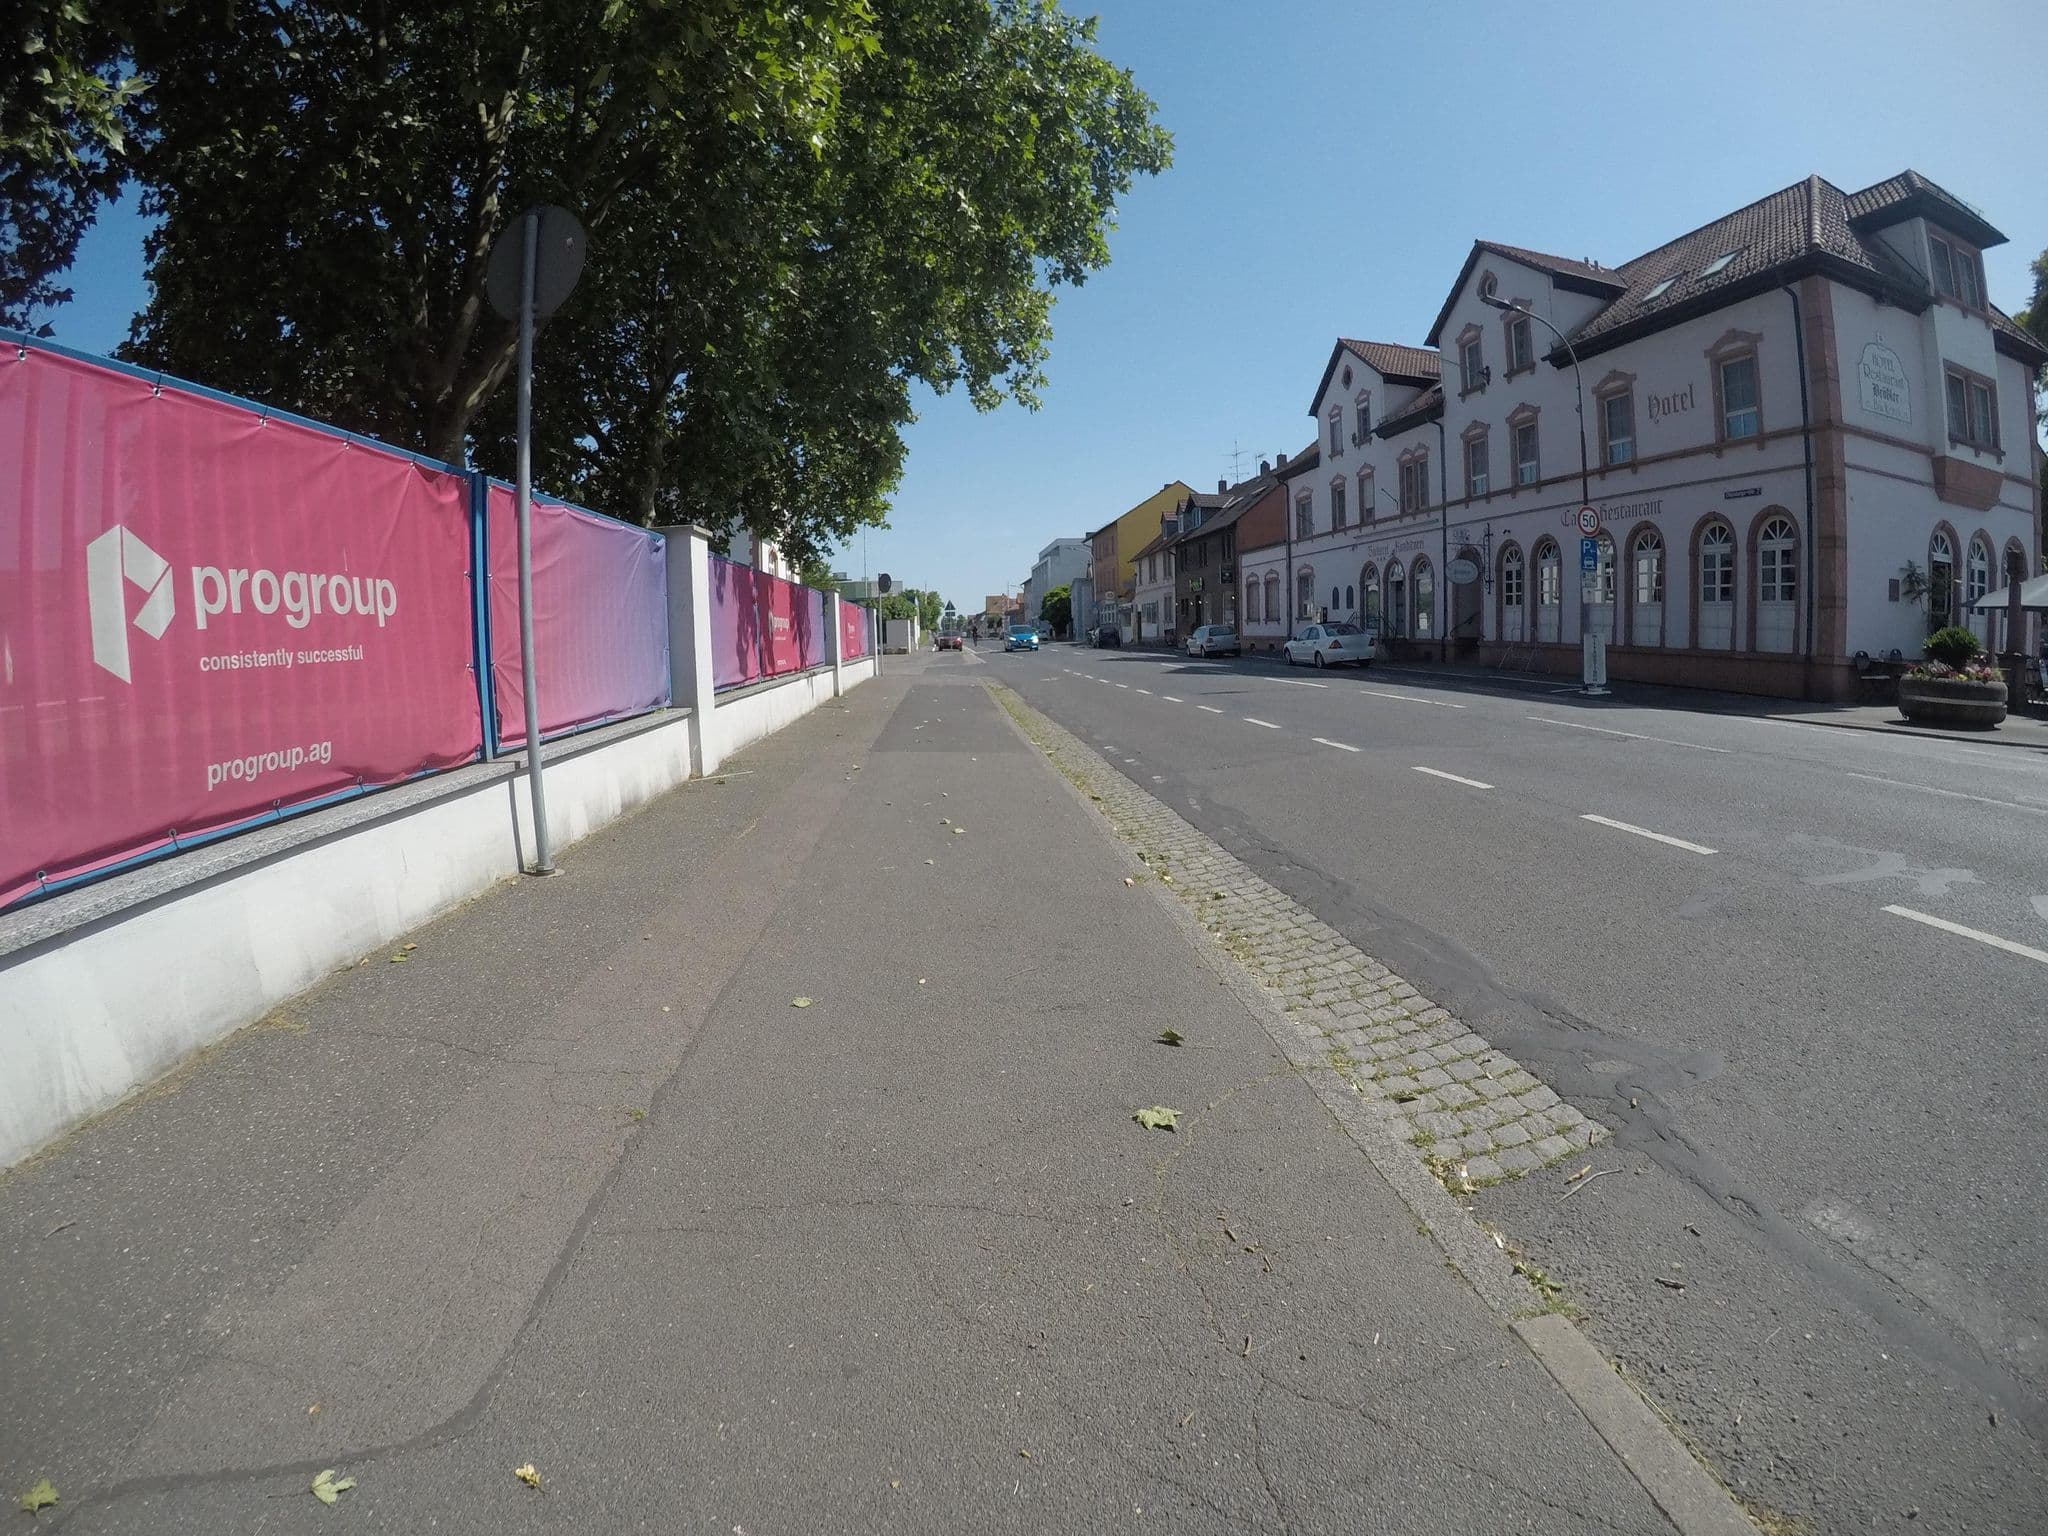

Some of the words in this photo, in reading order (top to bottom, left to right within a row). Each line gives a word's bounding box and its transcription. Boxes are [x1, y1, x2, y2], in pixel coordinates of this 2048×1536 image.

[1582, 514, 1596, 528] 50
[1583, 541, 1592, 554] P
[191, 566, 397, 630] progroup
[200, 648, 295, 672] consistently
[297, 644, 364, 665] successful
[207, 740, 332, 792] progroup.ag
